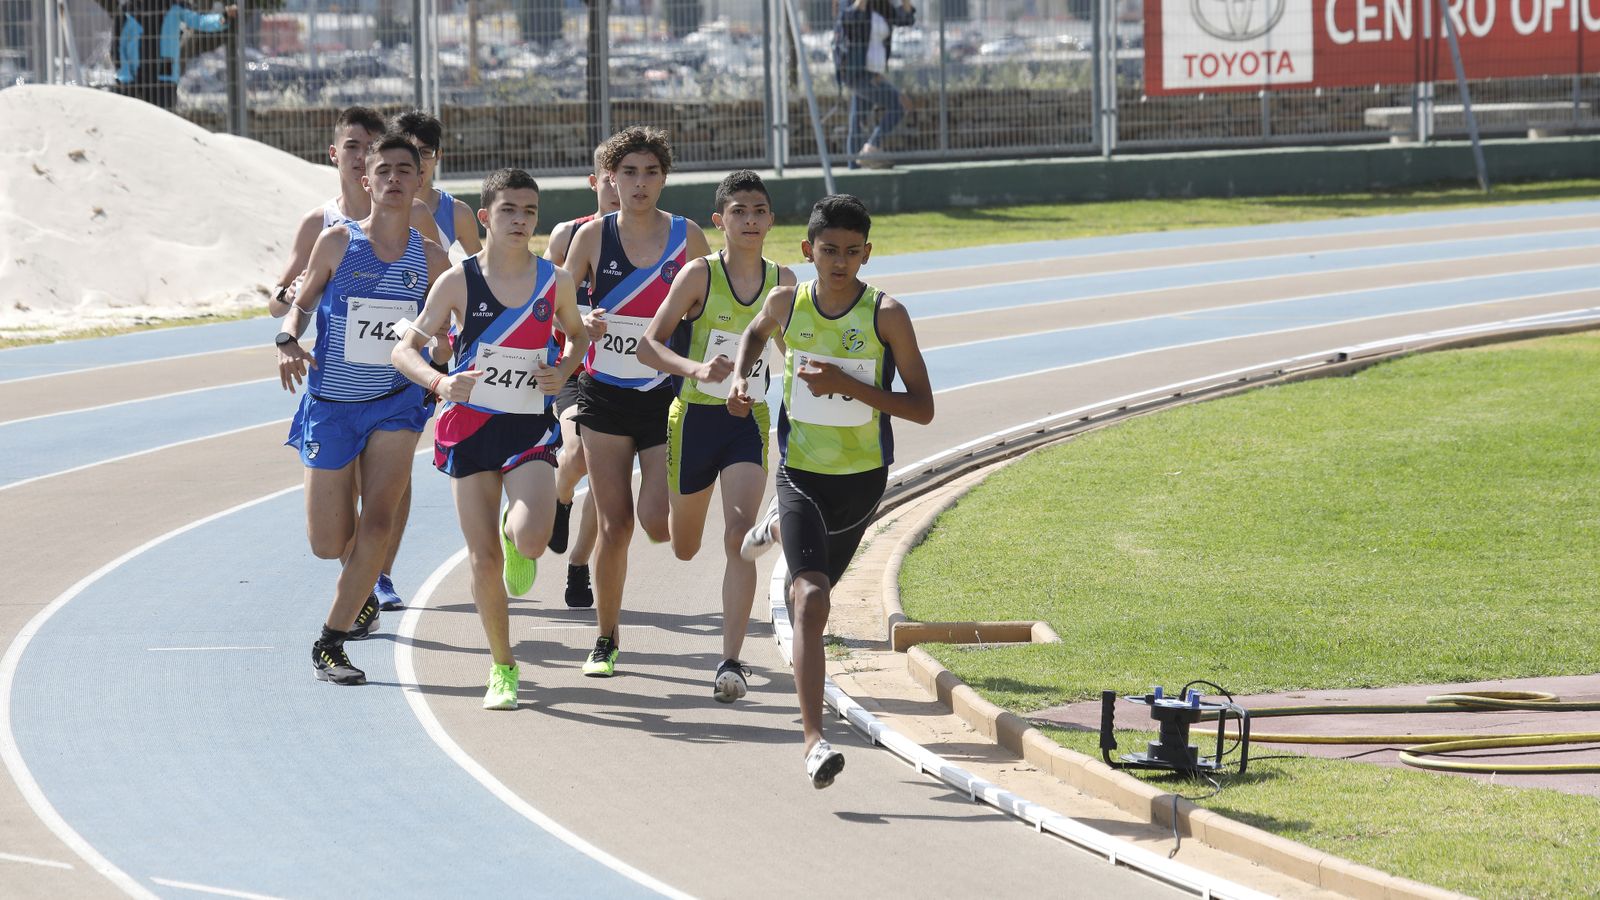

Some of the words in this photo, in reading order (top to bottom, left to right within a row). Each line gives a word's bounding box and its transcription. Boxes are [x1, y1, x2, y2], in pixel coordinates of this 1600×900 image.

[1183, 50, 1295, 78] TOYOTA
[357, 320, 402, 341] 742
[483, 366, 539, 389] 2474
